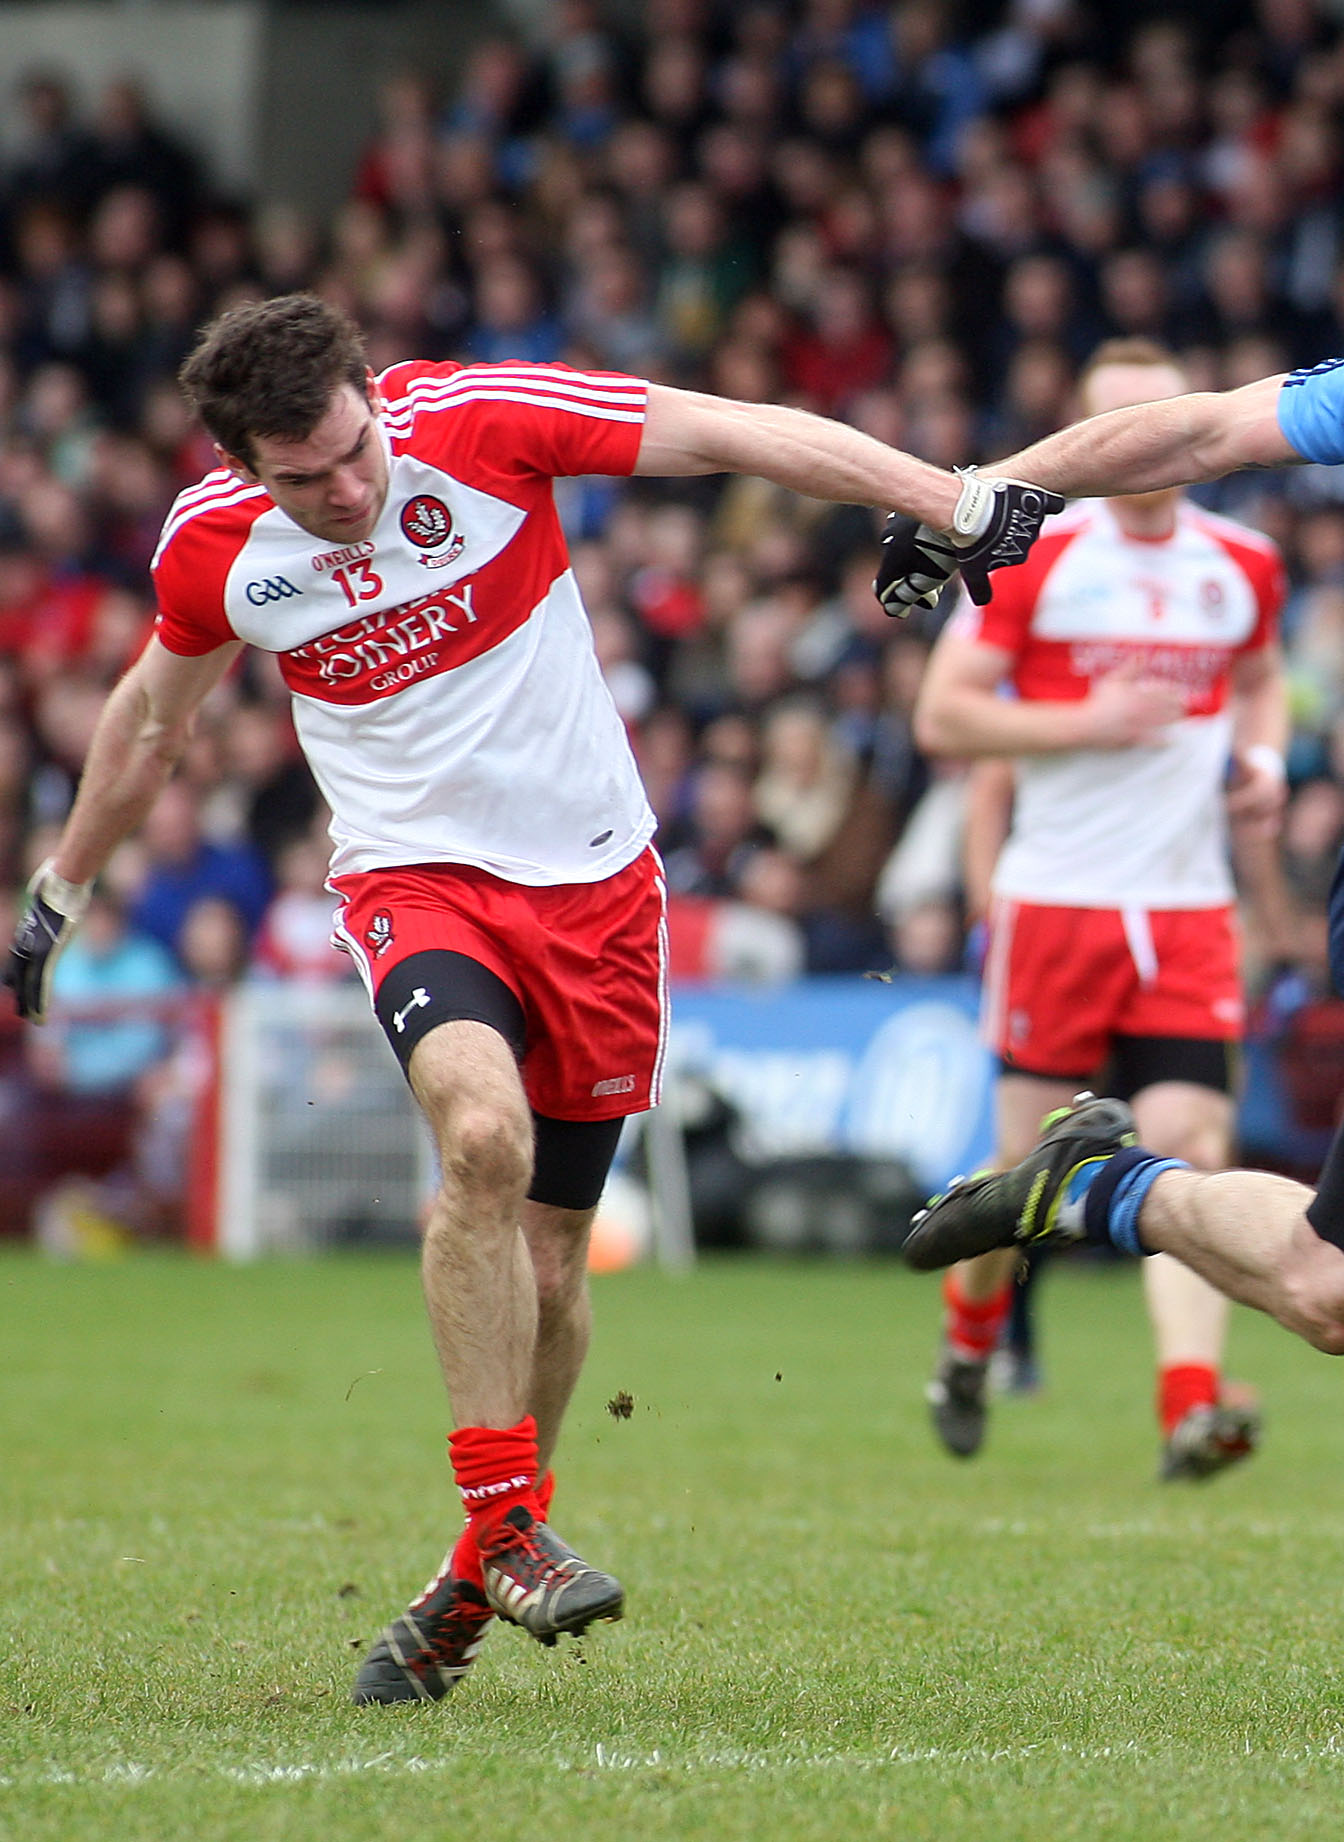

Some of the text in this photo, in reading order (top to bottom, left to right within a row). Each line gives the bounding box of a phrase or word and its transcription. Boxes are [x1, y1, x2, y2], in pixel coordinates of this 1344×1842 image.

[331, 558, 383, 607] 13
[317, 584, 478, 685] JOINERY
[369, 652, 440, 691] GROUP
